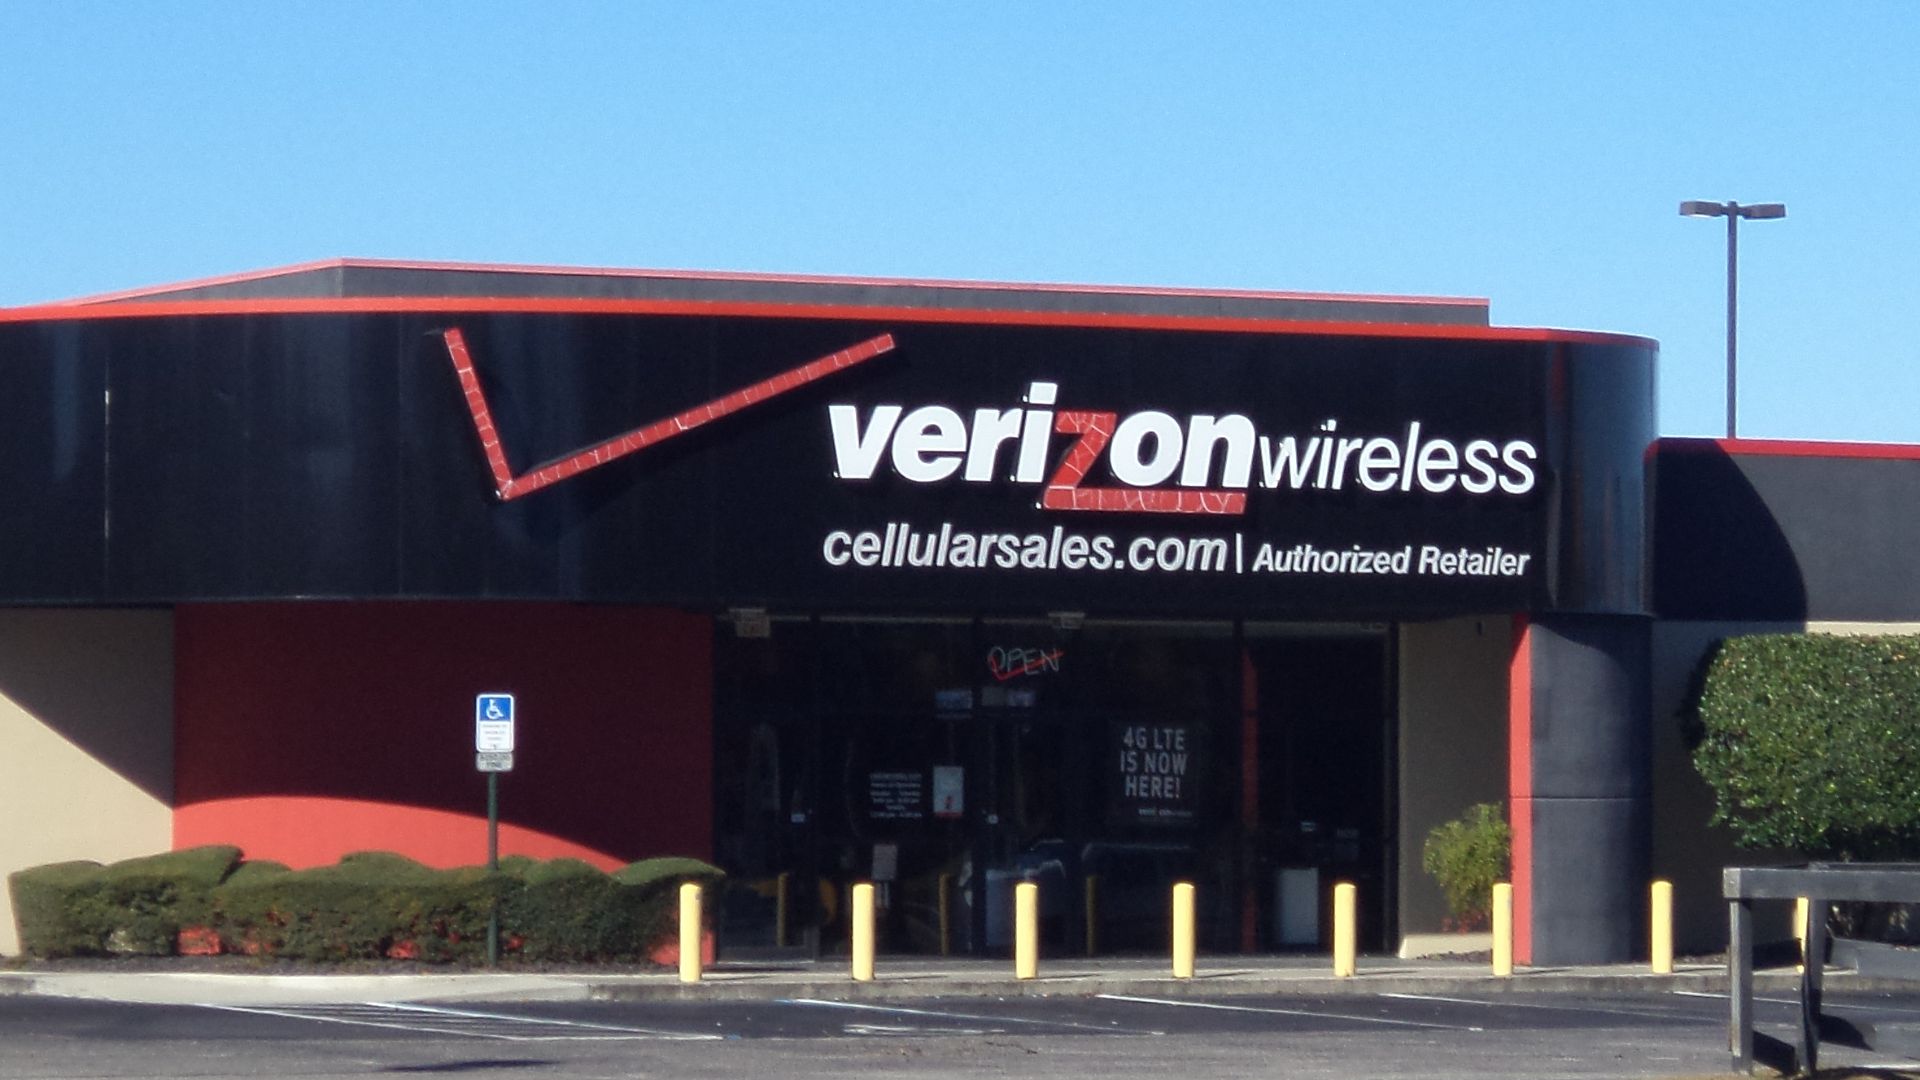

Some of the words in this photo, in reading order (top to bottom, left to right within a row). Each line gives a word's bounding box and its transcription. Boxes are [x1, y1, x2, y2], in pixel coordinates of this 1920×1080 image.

[828, 381, 1256, 514] verizon
[1259, 419, 1538, 494] wireless
[822, 522, 1229, 574] cellularsales.com
[1252, 542, 1412, 576] Authorized
[1417, 544, 1532, 577] Retailer
[986, 646, 1060, 677] OPEN
[1123, 726, 1147, 750] 4G
[1153, 727, 1185, 751] LTE
[1119, 749, 1138, 773] IS
[1144, 750, 1188, 776] NOW
[1125, 774, 1181, 800] HERE!
